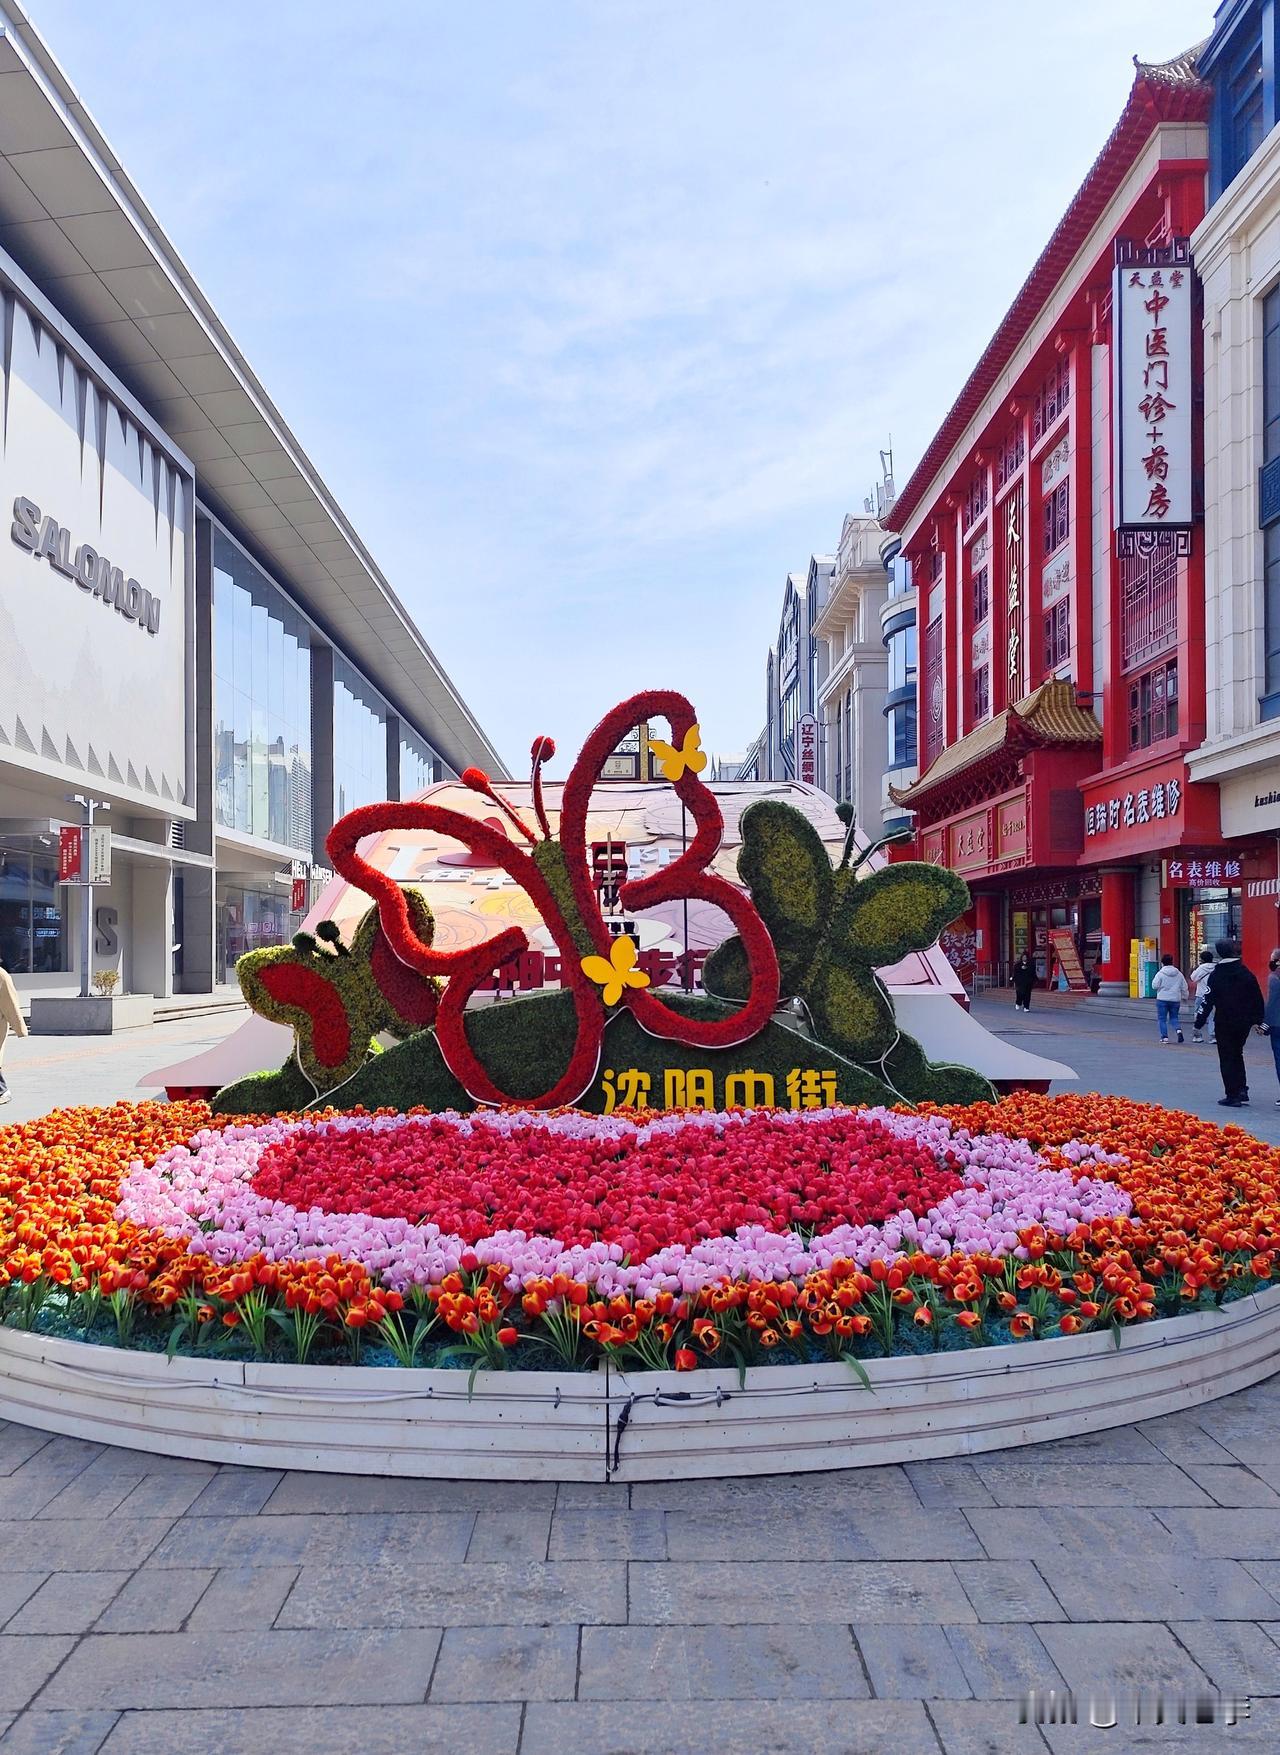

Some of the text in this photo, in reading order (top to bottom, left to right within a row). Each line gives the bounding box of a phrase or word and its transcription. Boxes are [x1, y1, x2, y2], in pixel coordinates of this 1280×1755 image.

[1128, 270, 1185, 289] 天益堂
[1138, 289, 1177, 519] 中医门诊+药房
[11, 496, 161, 637] SALOMON
[1168, 860, 1241, 878] 名表维修
[96, 907, 118, 955] S
[602, 1068, 838, 1115] 沈阳中街
